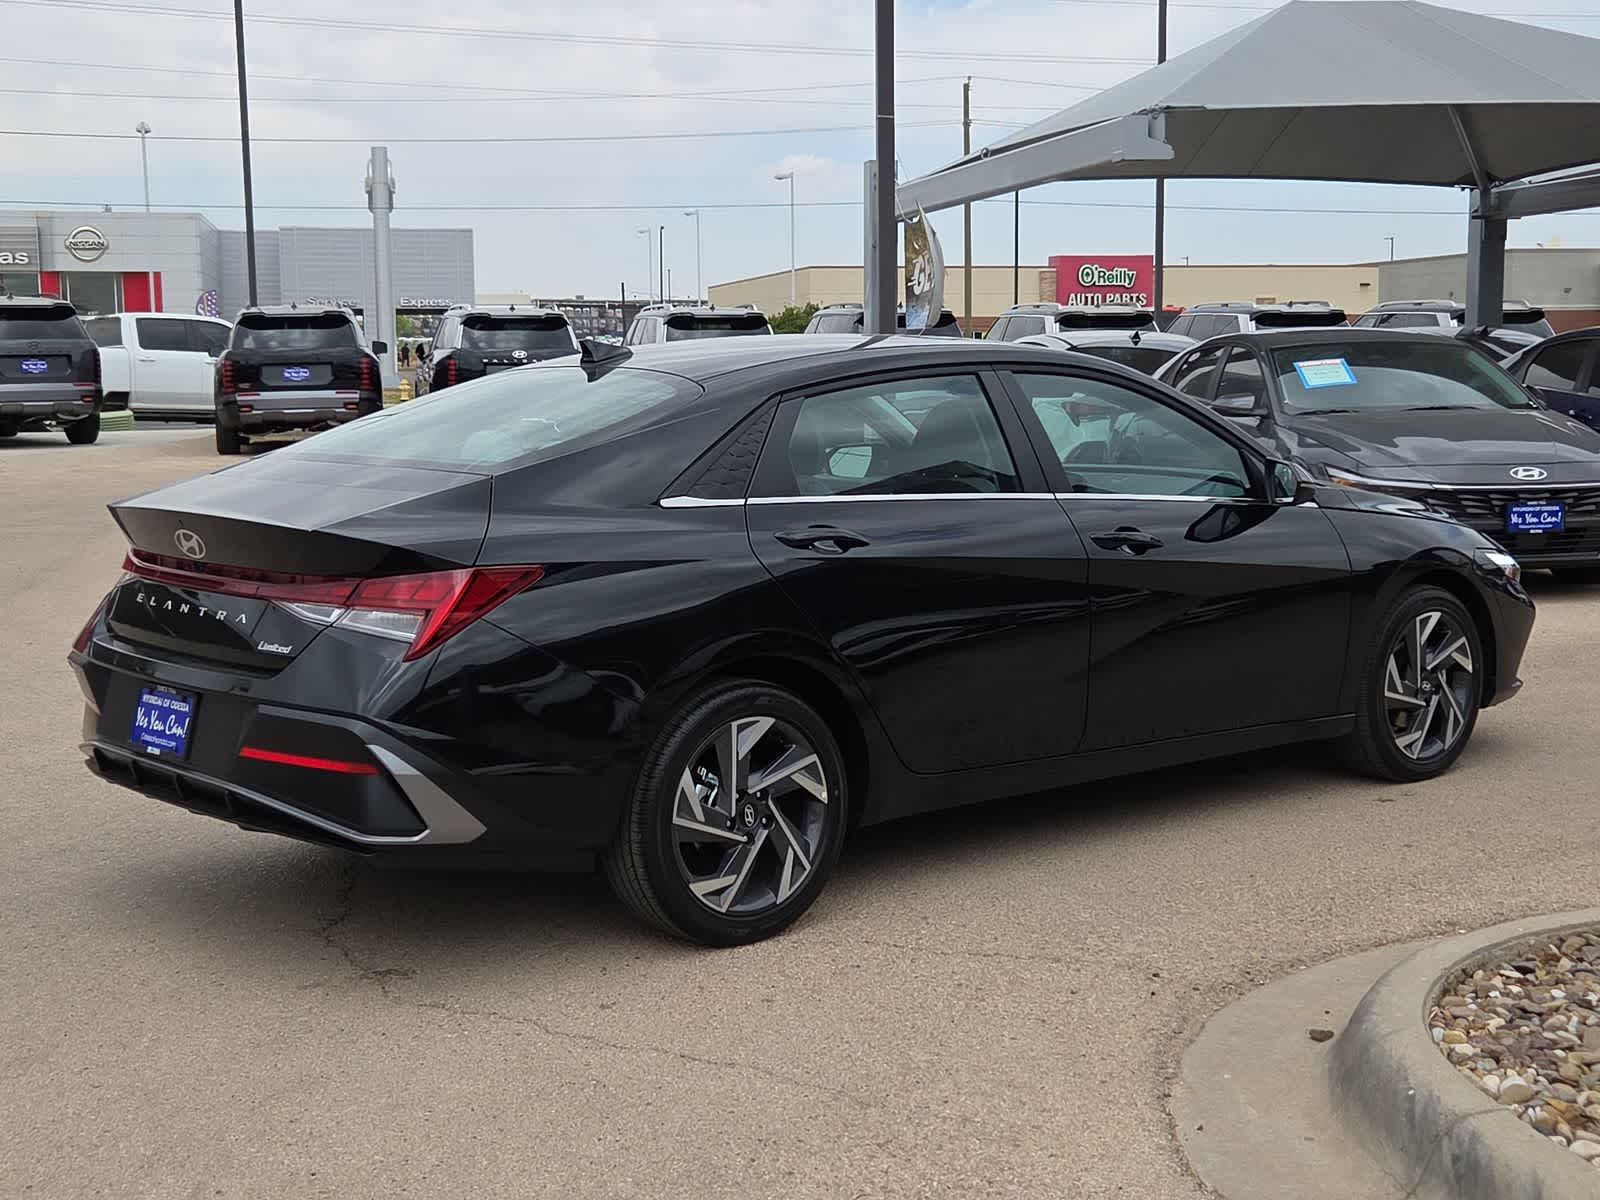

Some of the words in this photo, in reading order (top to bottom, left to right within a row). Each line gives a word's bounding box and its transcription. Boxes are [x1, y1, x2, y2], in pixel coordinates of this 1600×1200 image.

[69, 240, 105, 249] NISSAN
[1079, 264, 1136, 288] O'Reilly
[400, 297, 454, 308] Express
[1068, 293, 1102, 306] AUTO
[1106, 293, 1147, 306] PARTS
[136, 593, 247, 623] ELANTRA
[257, 640, 292, 654] Limited
[136, 706, 149, 728] Yes
[149, 709, 165, 731] You
[165, 714, 190, 738] Can!
